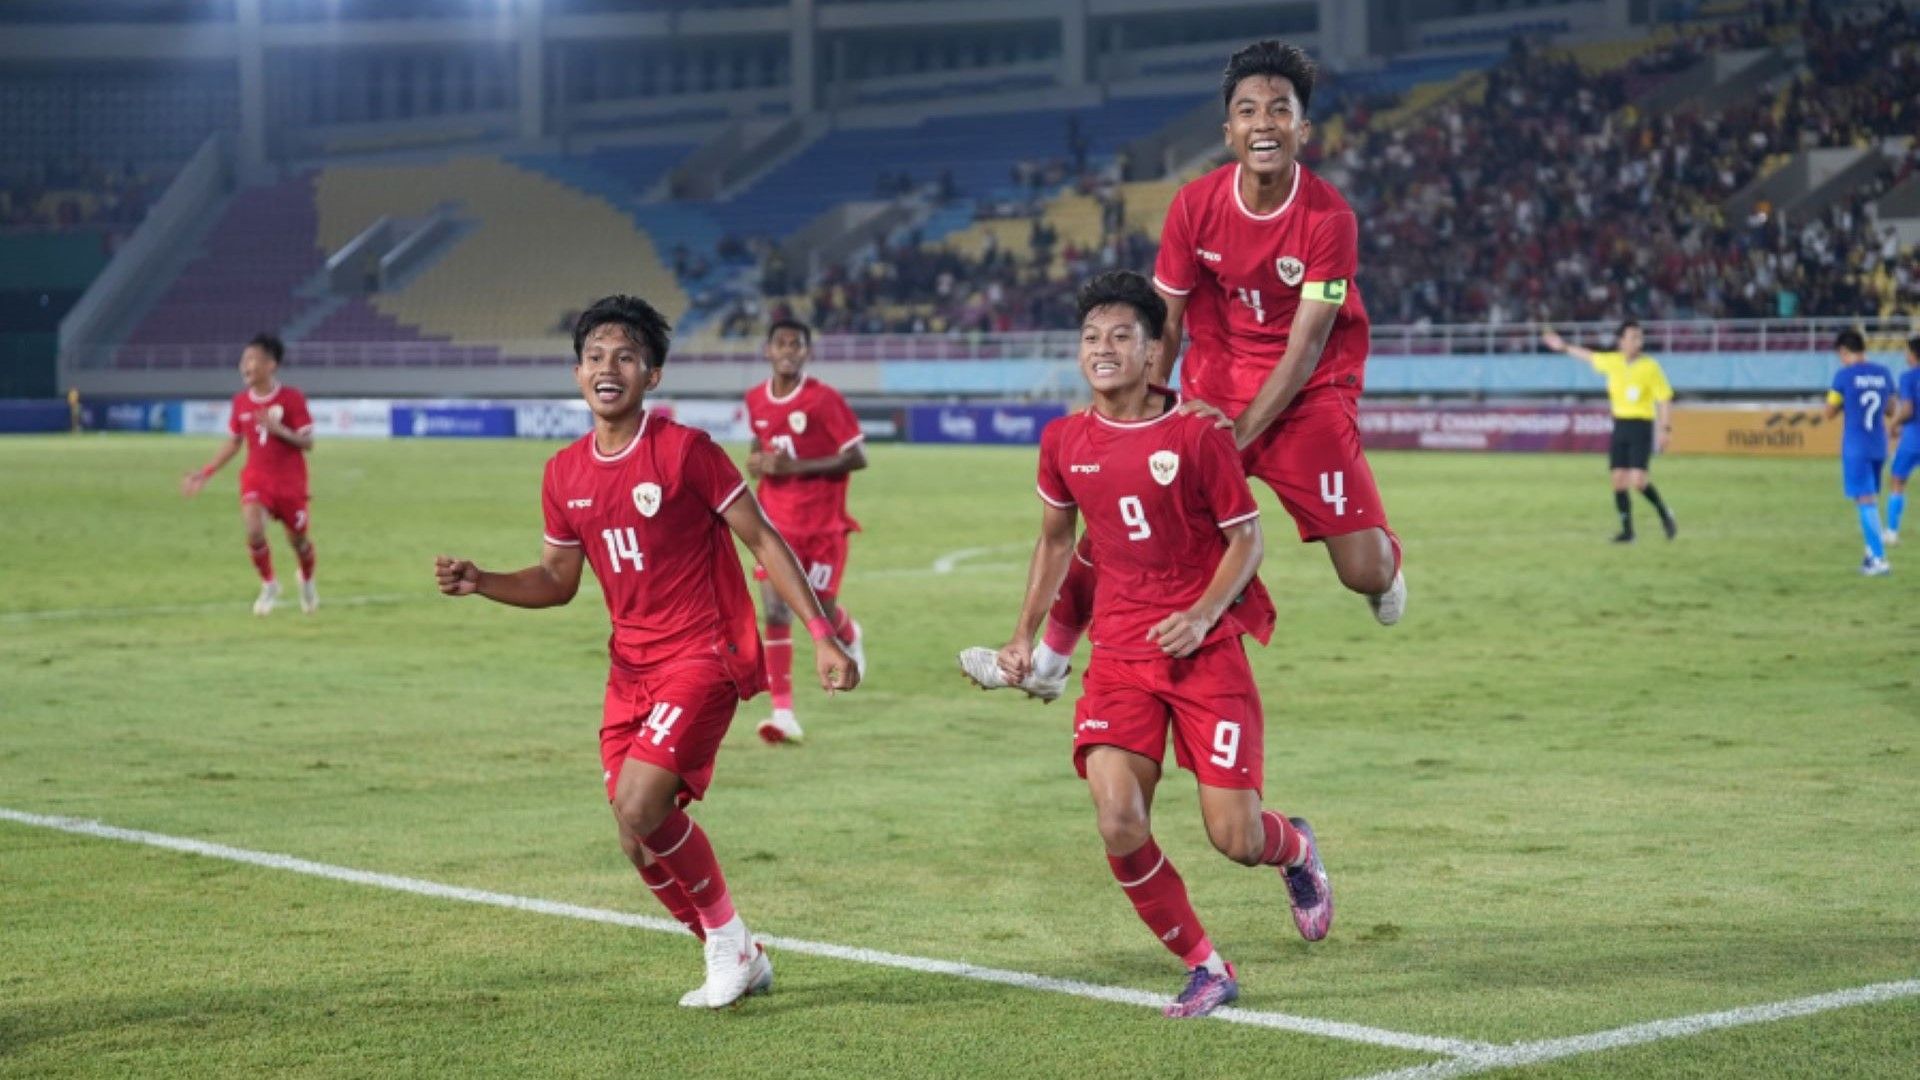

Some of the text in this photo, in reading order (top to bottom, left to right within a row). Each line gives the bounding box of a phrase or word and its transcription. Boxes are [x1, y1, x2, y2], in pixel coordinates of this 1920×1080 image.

[1238, 288, 1265, 324] 4
[1322, 278, 1344, 300] C
[1320, 471, 1348, 515] 4
[1118, 495, 1151, 541] 9
[601, 526, 644, 573] 14
[1209, 720, 1241, 769] 9
